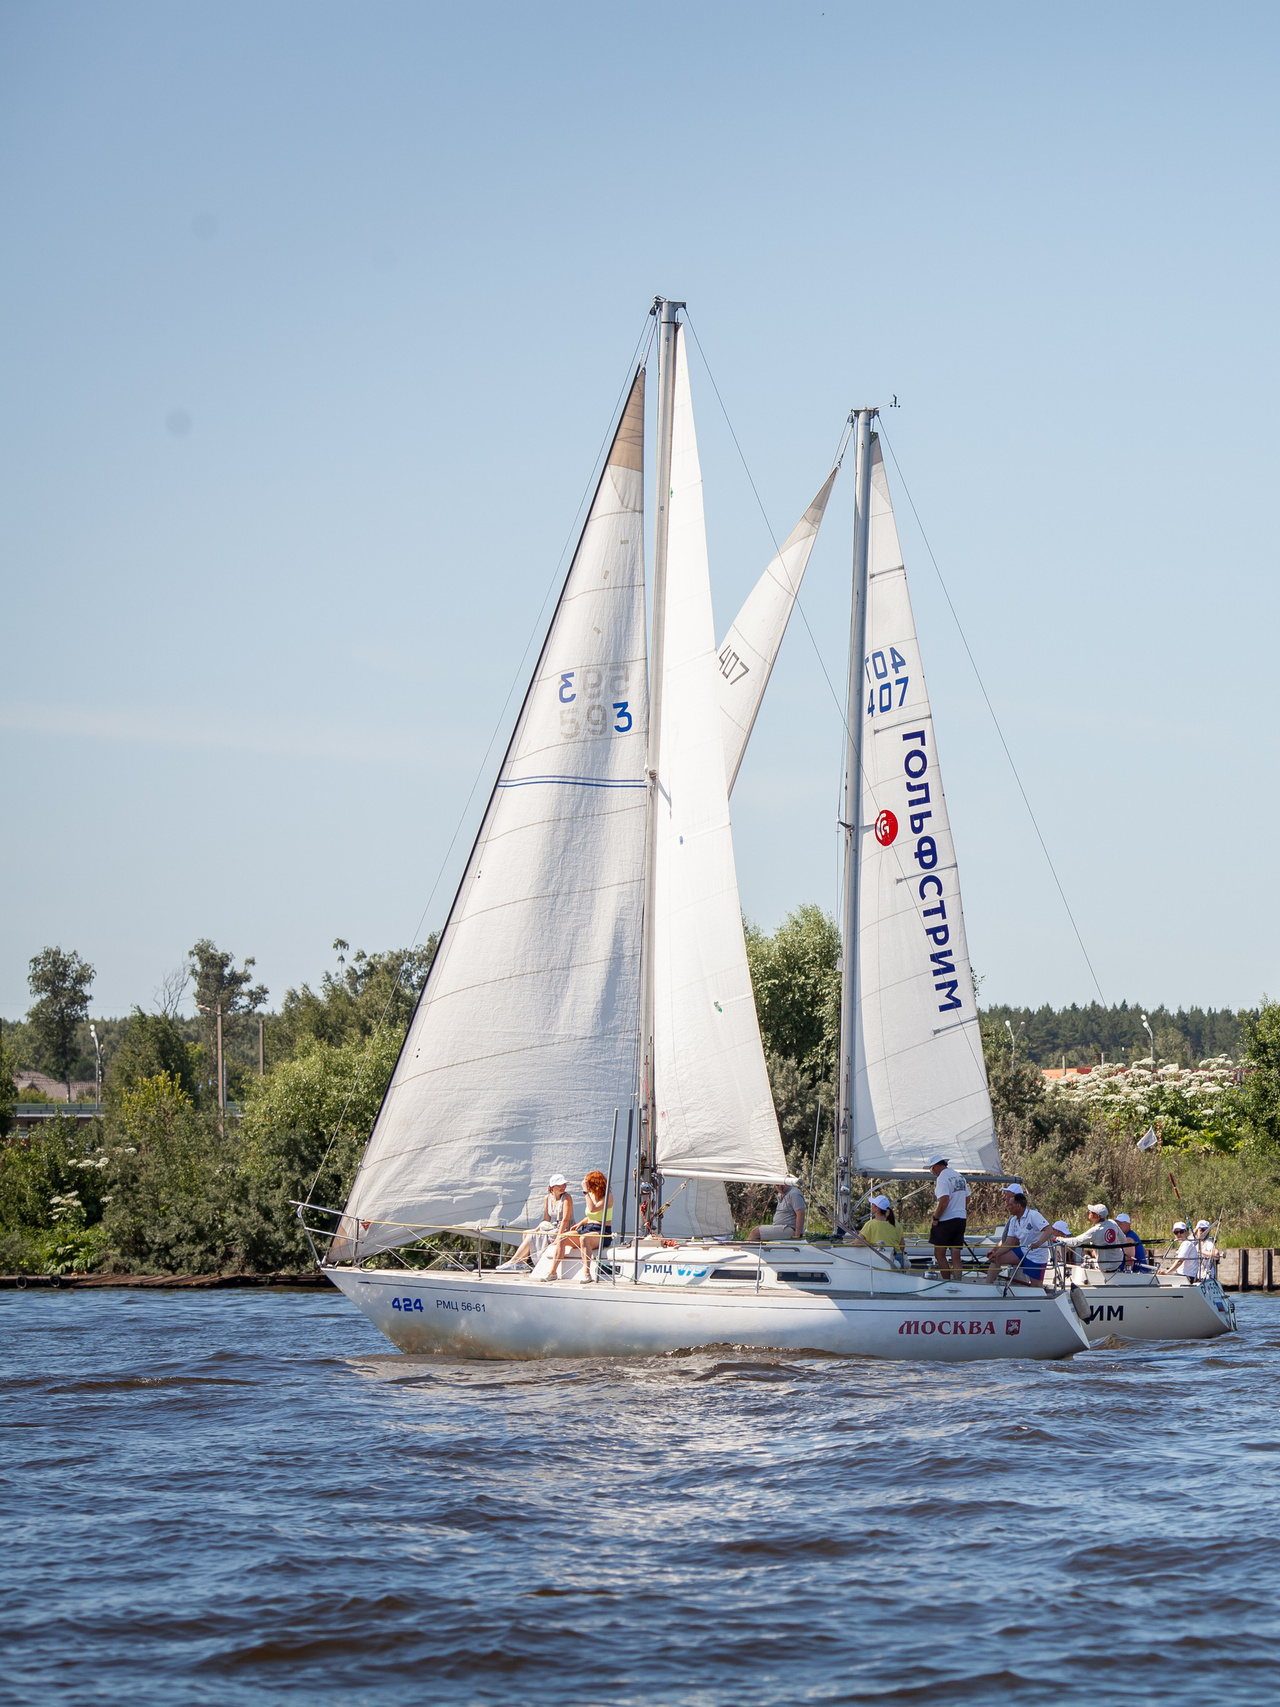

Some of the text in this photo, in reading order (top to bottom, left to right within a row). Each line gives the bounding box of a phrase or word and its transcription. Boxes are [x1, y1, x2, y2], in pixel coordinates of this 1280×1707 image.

[719, 645, 750, 685] 407
[867, 676, 909, 717] 407
[902, 730, 962, 1012] ГОЛЬФСТРИМ
[644, 1264, 673, 1275] РМЦ
[392, 1297, 424, 1312] 424
[436, 1299, 486, 1312] РМЦ 56-61
[1089, 1305, 1124, 1321] ИМ
[898, 1320, 996, 1335] МОСКВА
